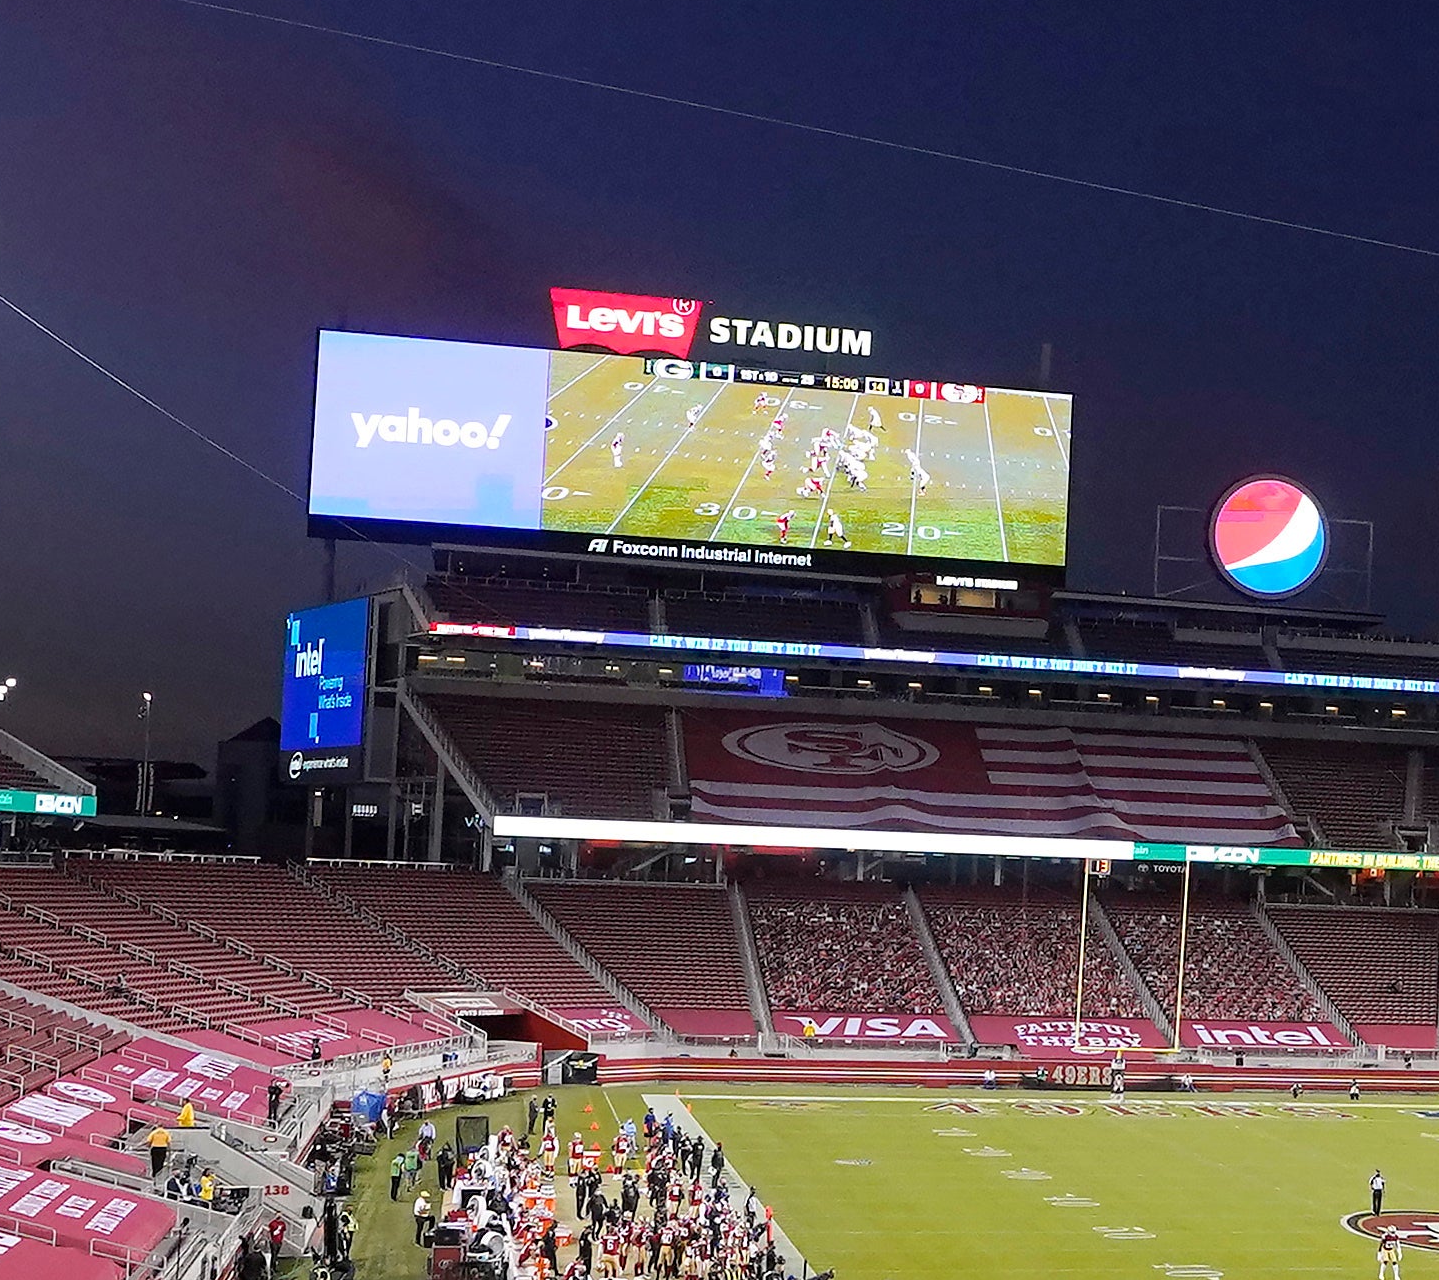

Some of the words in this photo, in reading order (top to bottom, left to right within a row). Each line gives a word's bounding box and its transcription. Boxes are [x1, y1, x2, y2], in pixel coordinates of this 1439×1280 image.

[708, 316, 873, 356] STADIUM
[824, 375, 859, 390] 15:00
[351, 406, 512, 451] yahoo!
[612, 539, 678, 559] Foxconn
[681, 543, 751, 563] Industrial
[754, 548, 812, 568] Internet
[295, 638, 326, 679] intel
[35, 793, 83, 816] DEVCON
[1186, 845, 1260, 864] DEVCON
[1310, 851, 1362, 869] PARTNERS
[1364, 853, 1374, 869] IN
[1375, 854, 1422, 871] BUILDING
[1093, 860, 1109, 874] 13
[784, 1016, 949, 1038] VISA
[1013, 1022, 1141, 1038] FAITHFUL
[1019, 1033, 1083, 1047] THE
[1084, 1036, 1142, 1049] BAY
[1051, 1066, 1113, 1086] 49ERS
[264, 1184, 290, 1197] 138
